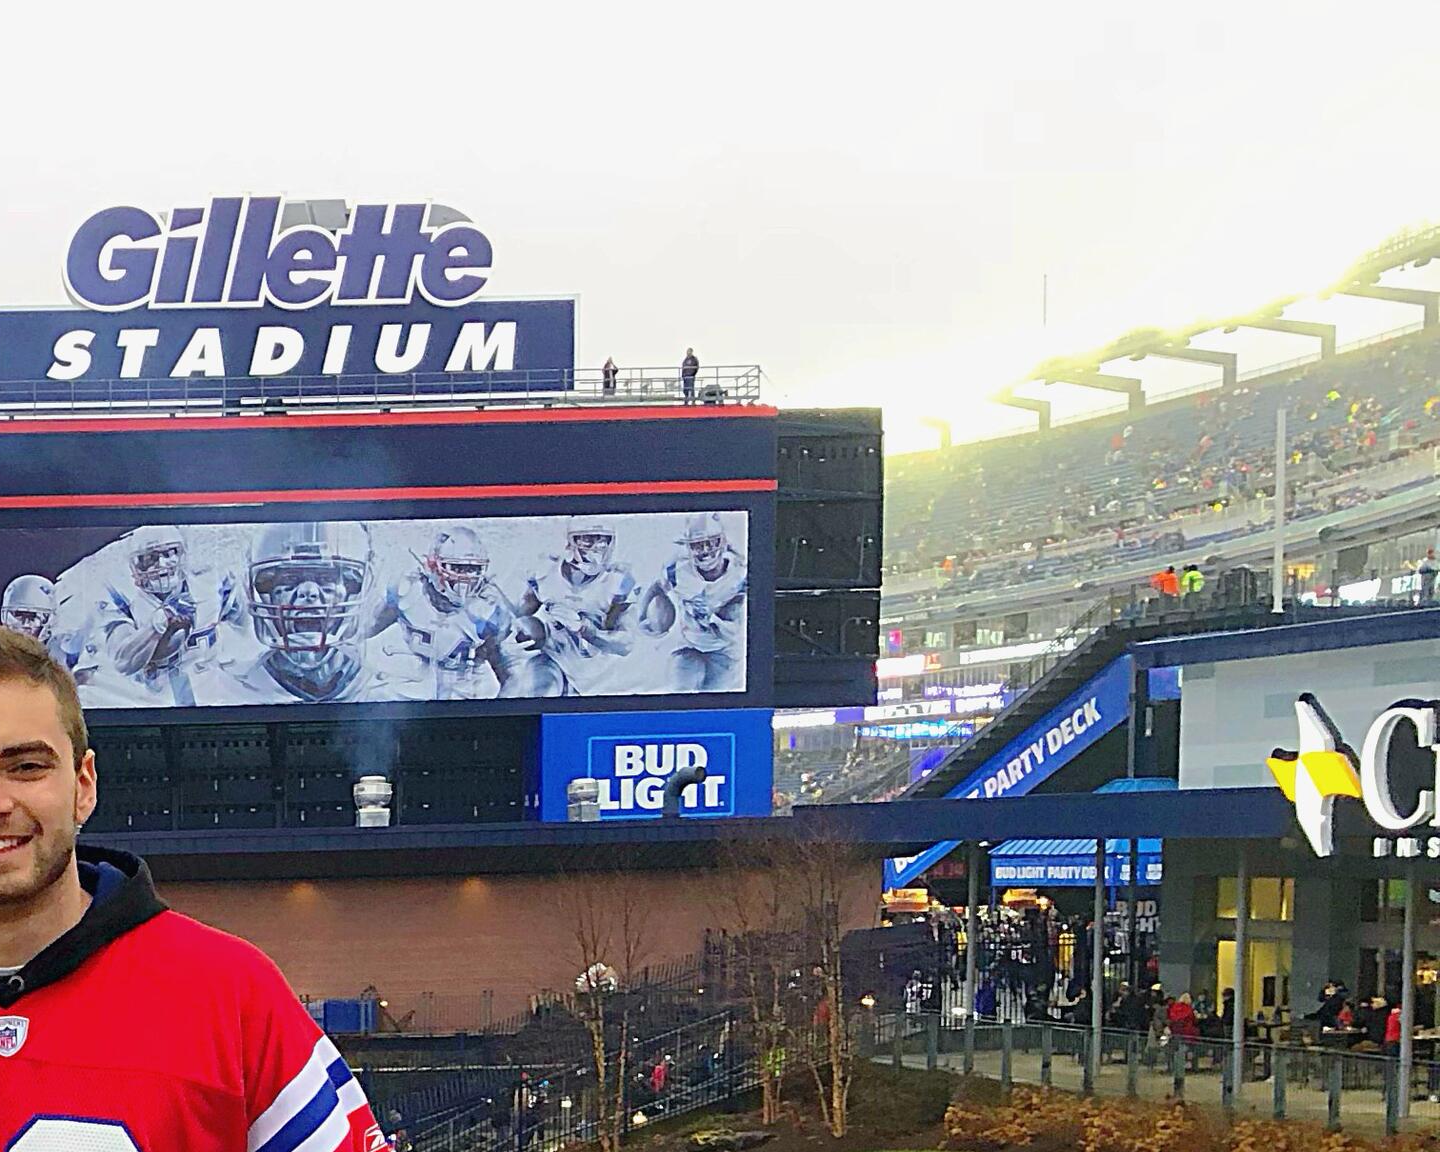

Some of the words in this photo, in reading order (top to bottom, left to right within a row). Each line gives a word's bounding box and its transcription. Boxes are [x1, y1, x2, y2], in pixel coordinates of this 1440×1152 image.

[65, 195, 494, 311] Gillette
[46, 322, 517, 380] STADIUM
[615, 743, 708, 777] BUD
[984, 738, 1045, 798] PARTY
[1046, 698, 1102, 755] DECK
[1361, 706, 1440, 830] C
[995, 866, 1017, 879] BUD
[1017, 866, 1045, 879] LIGHT
[1047, 866, 1079, 879] PARTY
